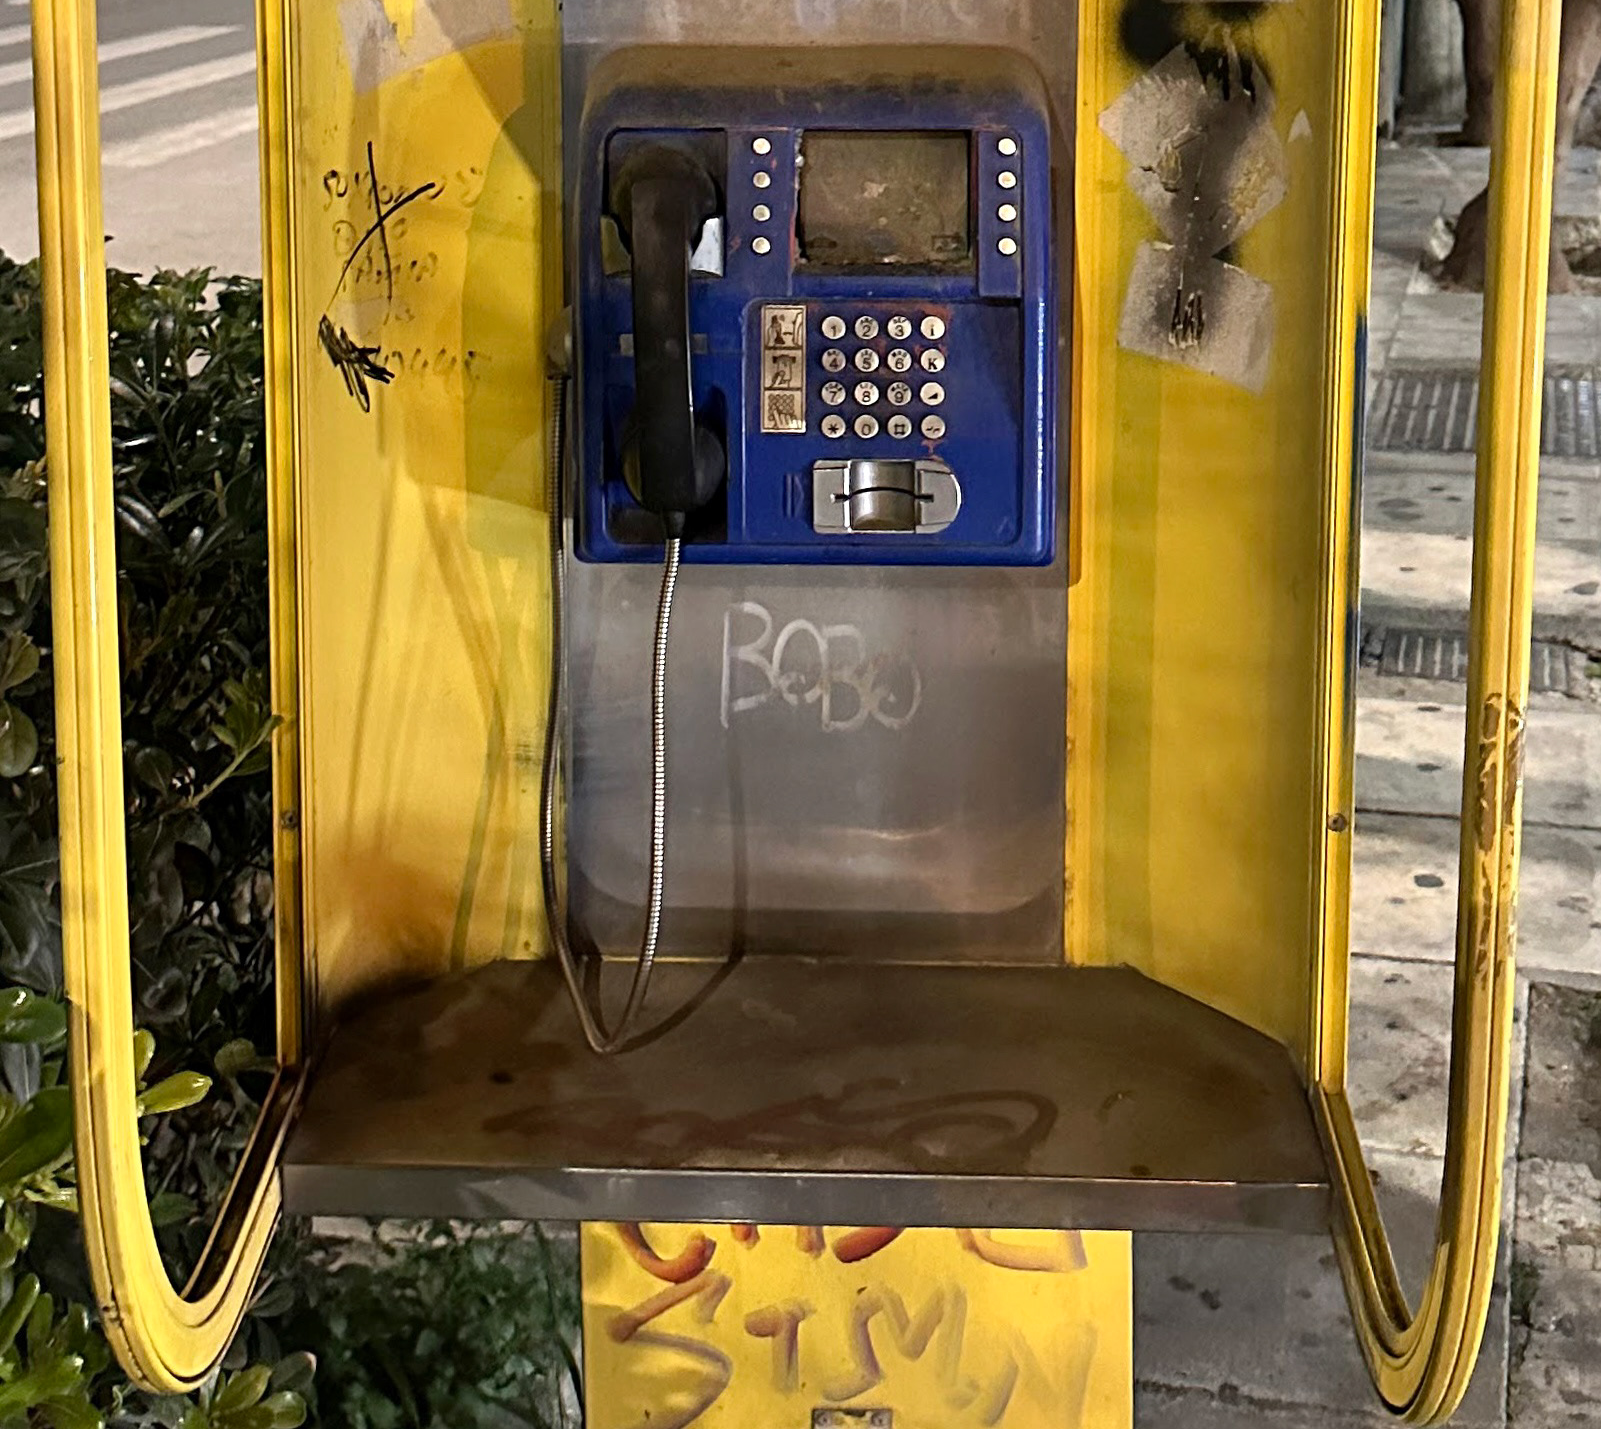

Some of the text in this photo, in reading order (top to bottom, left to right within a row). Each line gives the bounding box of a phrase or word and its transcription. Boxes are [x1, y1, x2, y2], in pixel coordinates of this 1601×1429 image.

[862, 325, 871, 337] 2
[894, 325, 904, 337] 3
[829, 357, 838, 369] 4
[862, 357, 872, 370] 5
[894, 357, 904, 370] 6
[829, 391, 904, 404] 7 8 9
[861, 424, 871, 436] 0
